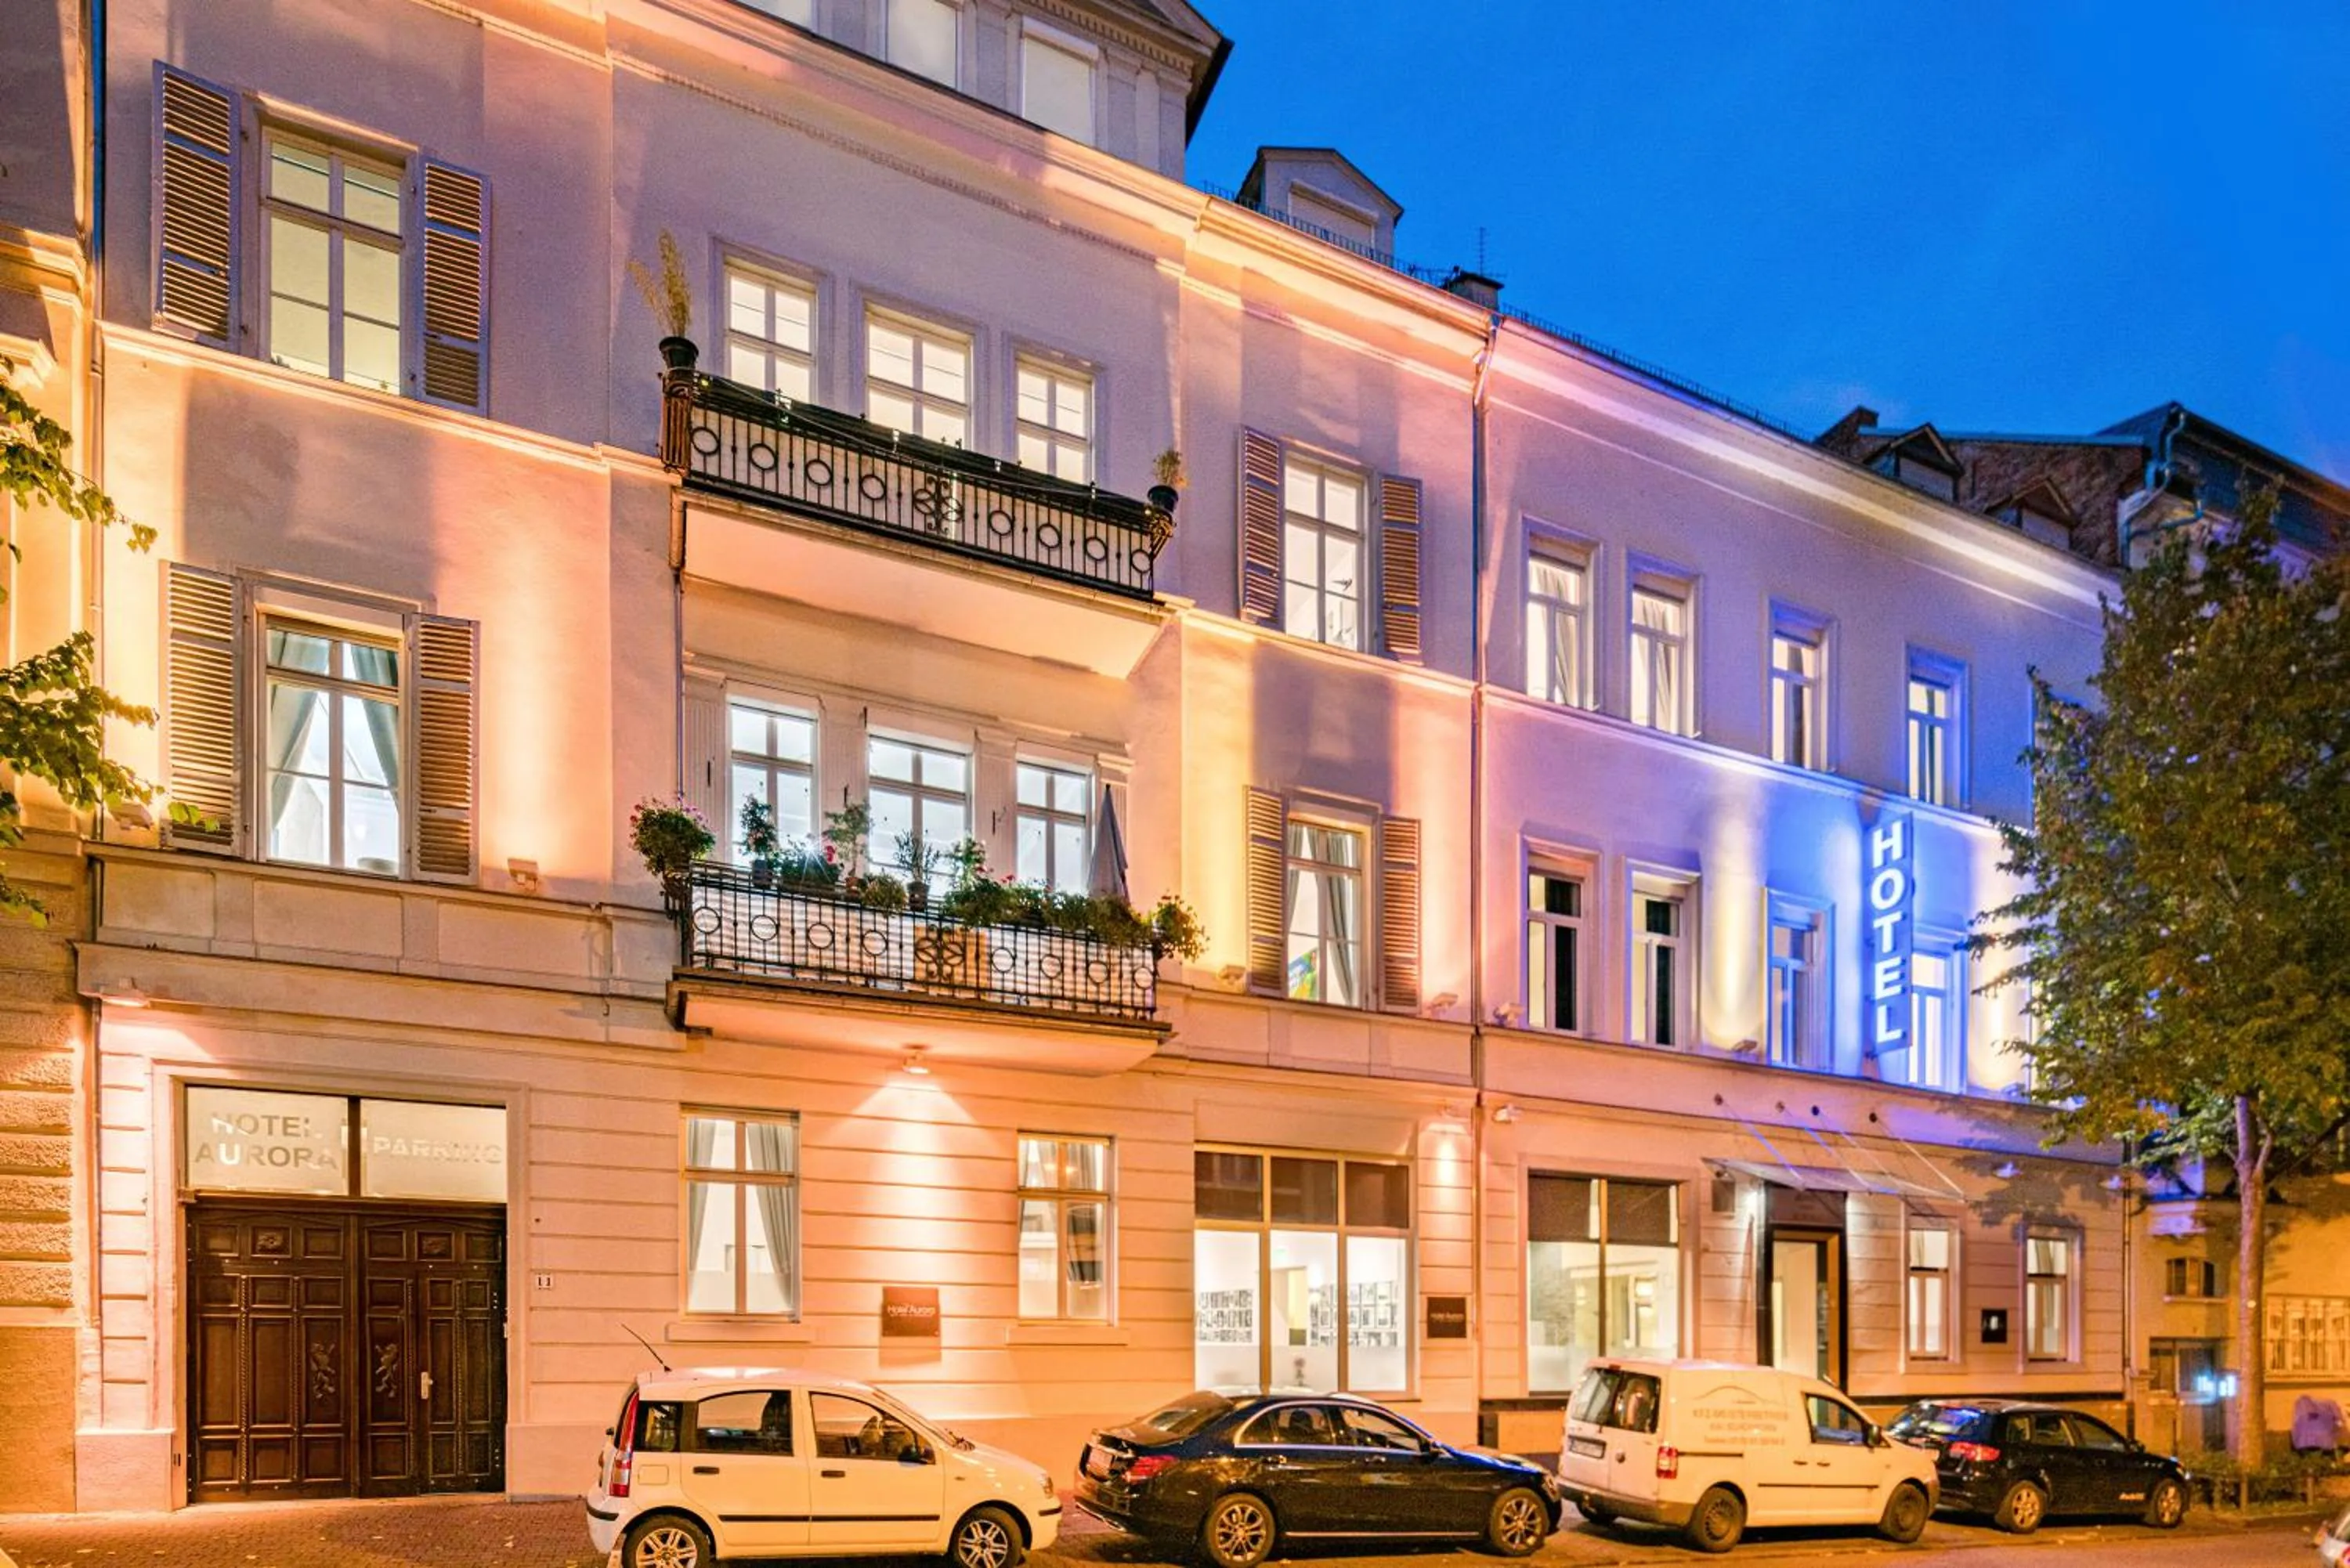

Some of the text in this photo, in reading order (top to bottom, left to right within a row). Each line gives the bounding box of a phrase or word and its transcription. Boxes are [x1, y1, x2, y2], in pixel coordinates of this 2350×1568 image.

[1871, 821, 1905, 1043] HOTEL
[195, 1142, 338, 1170] AURORA
[373, 1136, 503, 1164] PARKING
